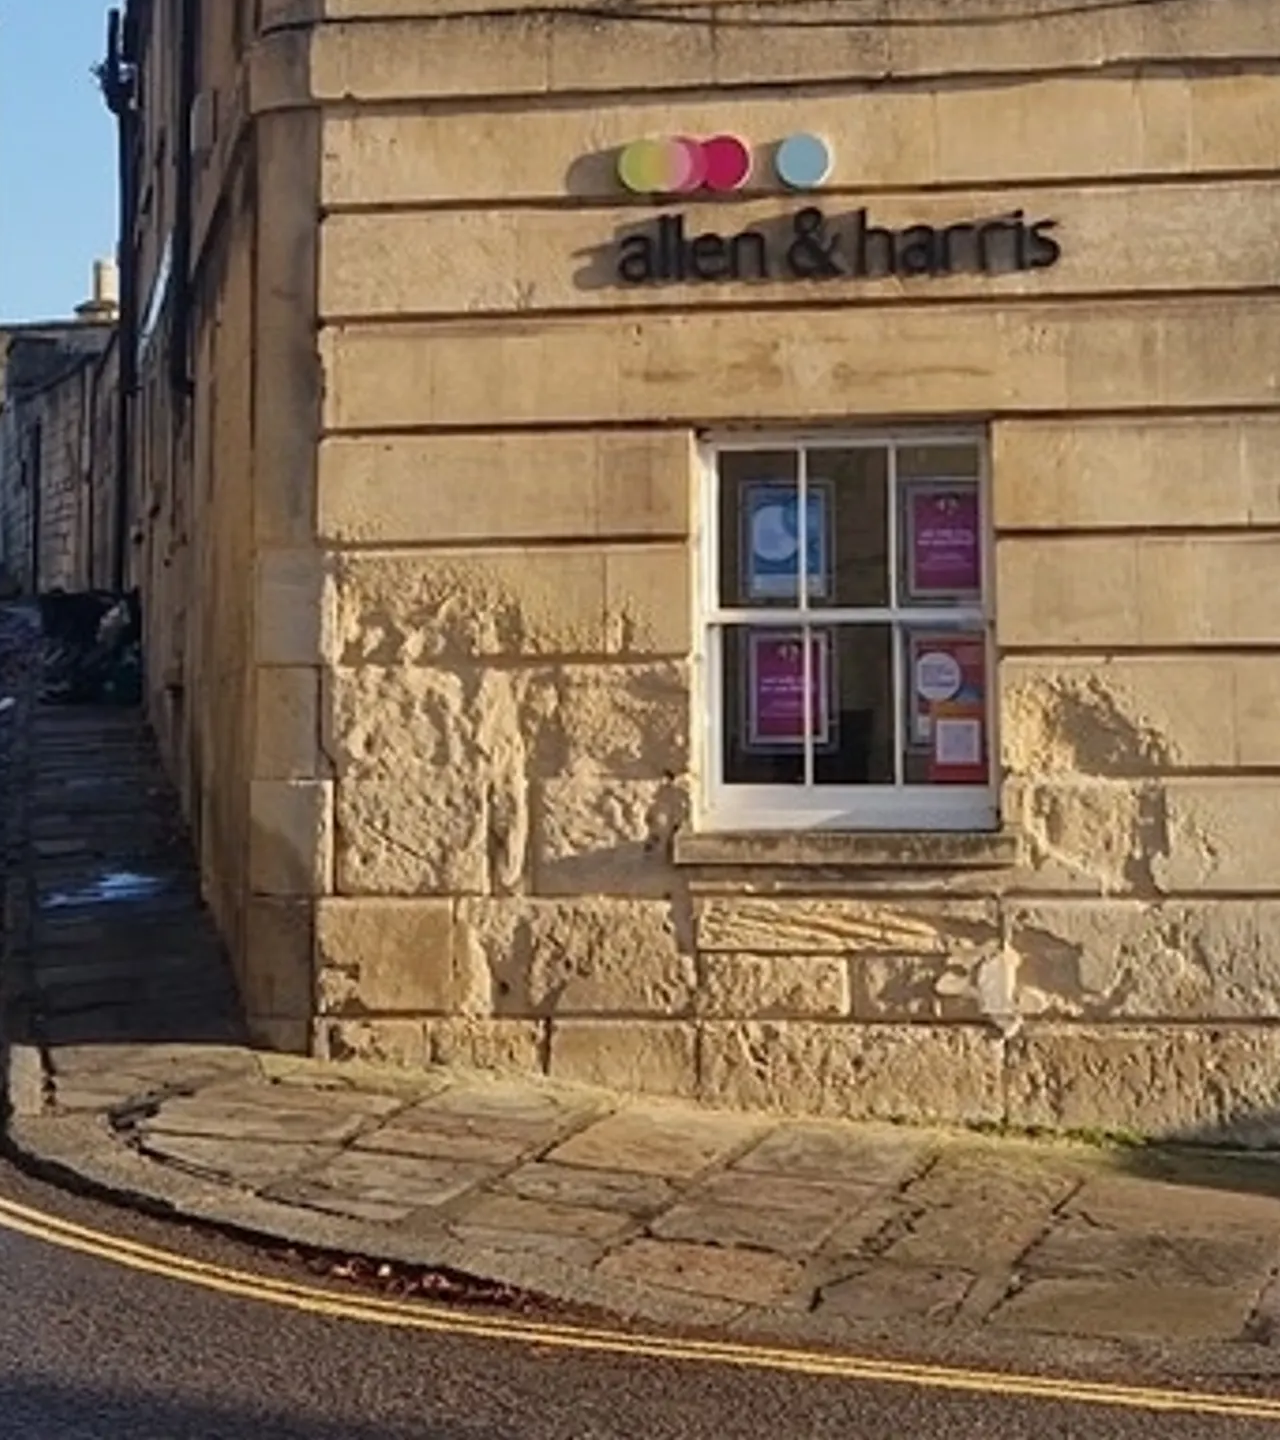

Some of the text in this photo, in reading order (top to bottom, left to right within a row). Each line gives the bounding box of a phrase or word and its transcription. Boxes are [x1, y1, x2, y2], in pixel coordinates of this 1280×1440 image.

[618, 206, 1061, 282] allen & harris
